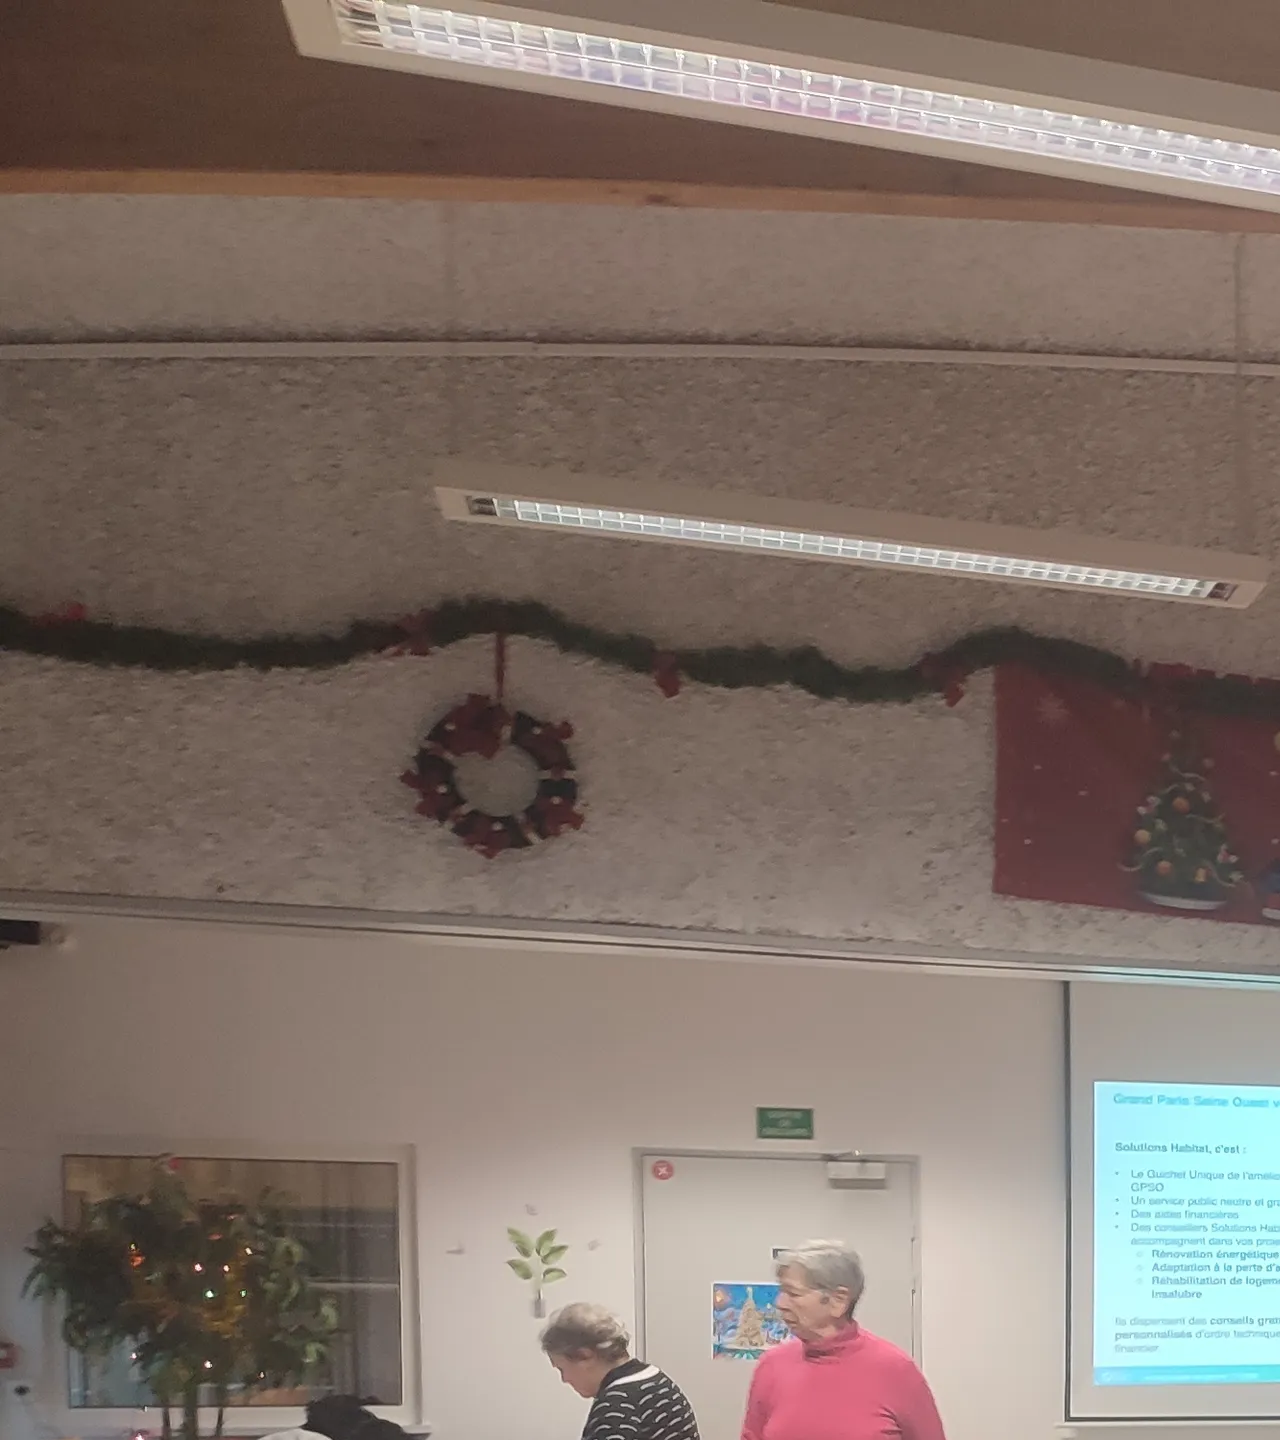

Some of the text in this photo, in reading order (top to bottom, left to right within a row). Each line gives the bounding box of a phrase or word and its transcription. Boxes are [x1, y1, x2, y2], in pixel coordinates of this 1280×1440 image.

[1115, 1142, 1167, 1152] Solutions
[1215, 1144, 1240, 1154] c'est
[1130, 1169, 1144, 1179] Le
[1147, 1169, 1187, 1179] Guichet
[1189, 1169, 1225, 1181] Unique
[1227, 1171, 1240, 1180] de
[1130, 1182, 1164, 1192] GPSO
[1130, 1195, 1146, 1205] Un
[1148, 1197, 1185, 1206] service
[1187, 1197, 1217, 1207] public
[1220, 1197, 1252, 1206] neutre
[1254, 1197, 1264, 1206] et
[1130, 1209, 1151, 1219] Des
[1152, 1249, 1280, 1261] Rénovation énergétique
[1152, 1262, 1211, 1273] Adaptation
[1213, 1262, 1220, 1272] à
[1223, 1263, 1233, 1272] la
[1235, 1263, 1263, 1273] perte
[1152, 1275, 1227, 1285] Réhabilitation
[1229, 1276, 1243, 1285] de
[1209, 1315, 1255, 1325] conseils
